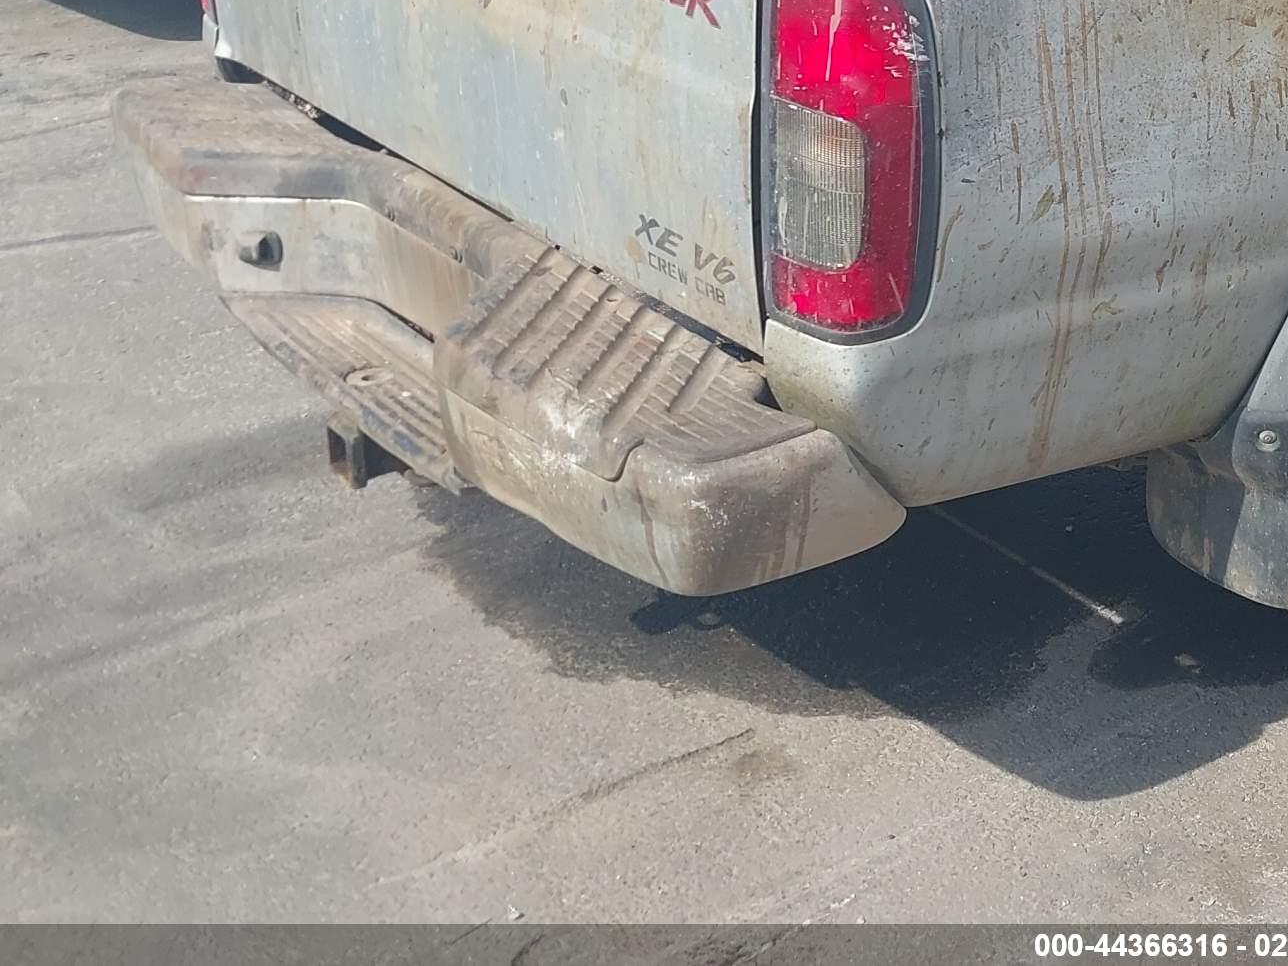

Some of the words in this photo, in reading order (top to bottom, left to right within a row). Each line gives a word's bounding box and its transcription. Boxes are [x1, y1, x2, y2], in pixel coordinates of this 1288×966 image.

[634, 213, 683, 257] XE
[694, 242, 736, 285] V6
[648, 251, 688, 284] CREW
[695, 276, 727, 306] CAB
